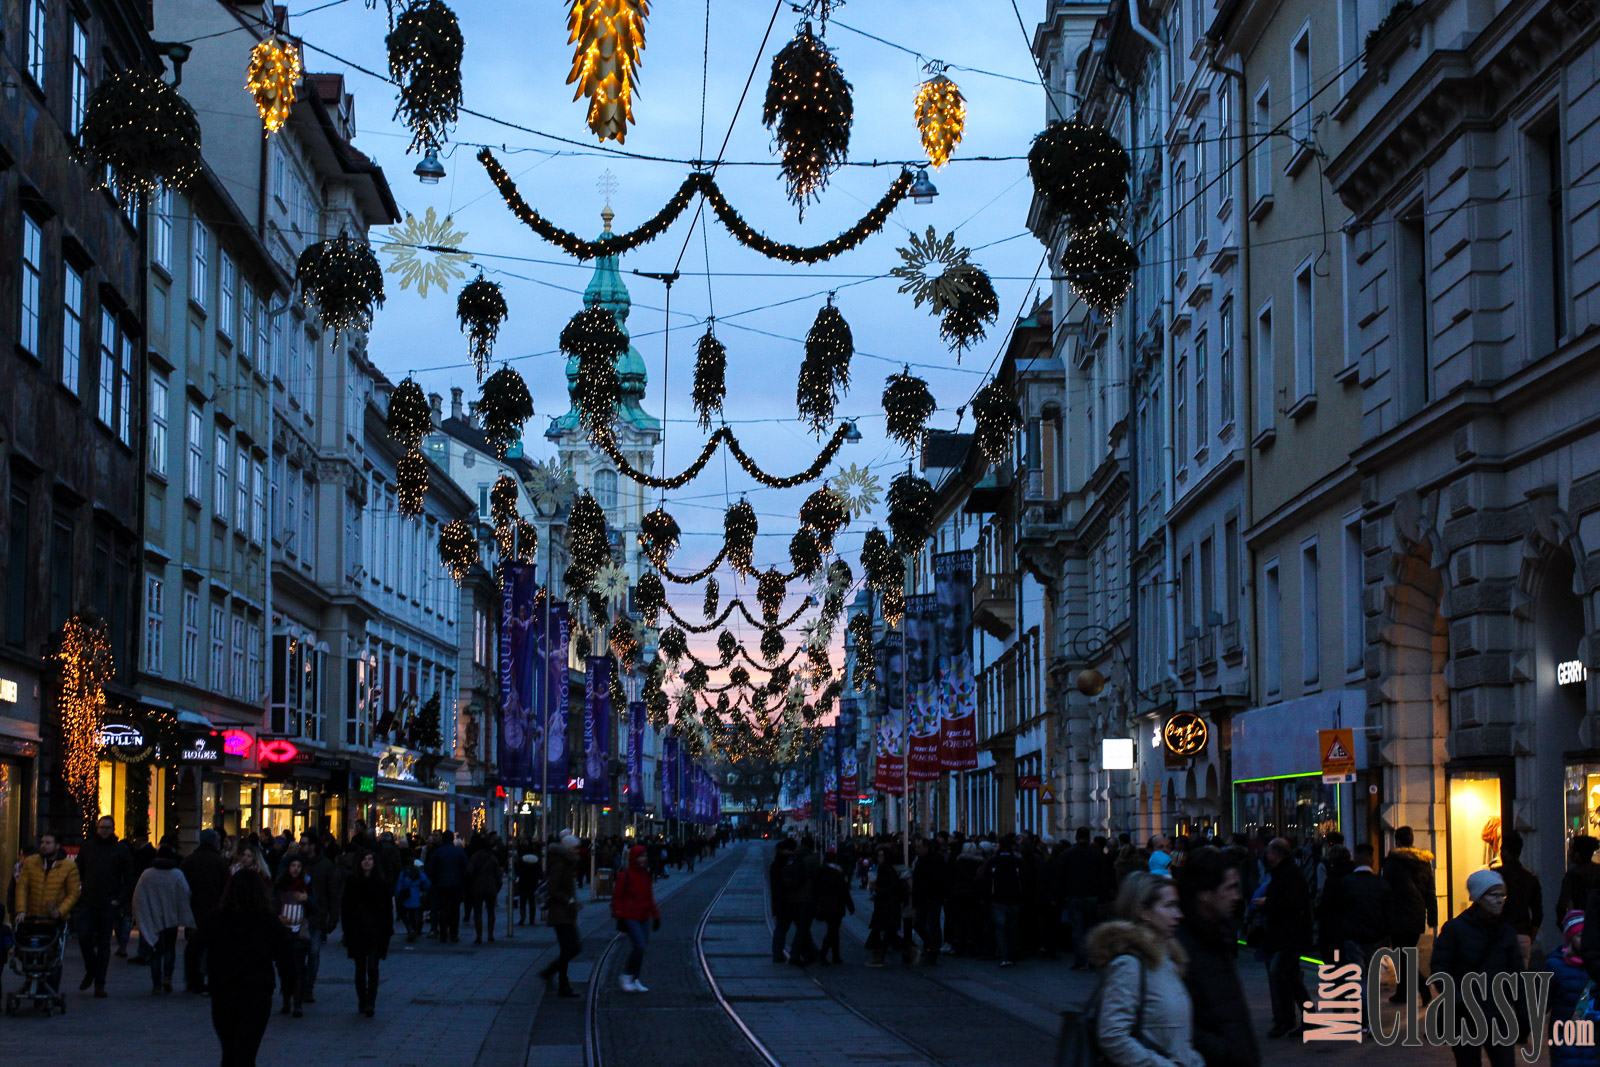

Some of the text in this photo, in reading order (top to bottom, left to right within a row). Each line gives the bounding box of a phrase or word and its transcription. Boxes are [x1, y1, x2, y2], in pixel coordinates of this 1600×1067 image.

[936, 553, 971, 565] SPECIAL
[936, 562, 972, 574] OLYMPICS
[501, 631, 515, 708] CIRQUE
[1557, 659, 1583, 686] GERRY
[182, 749, 218, 760] ROLEX
